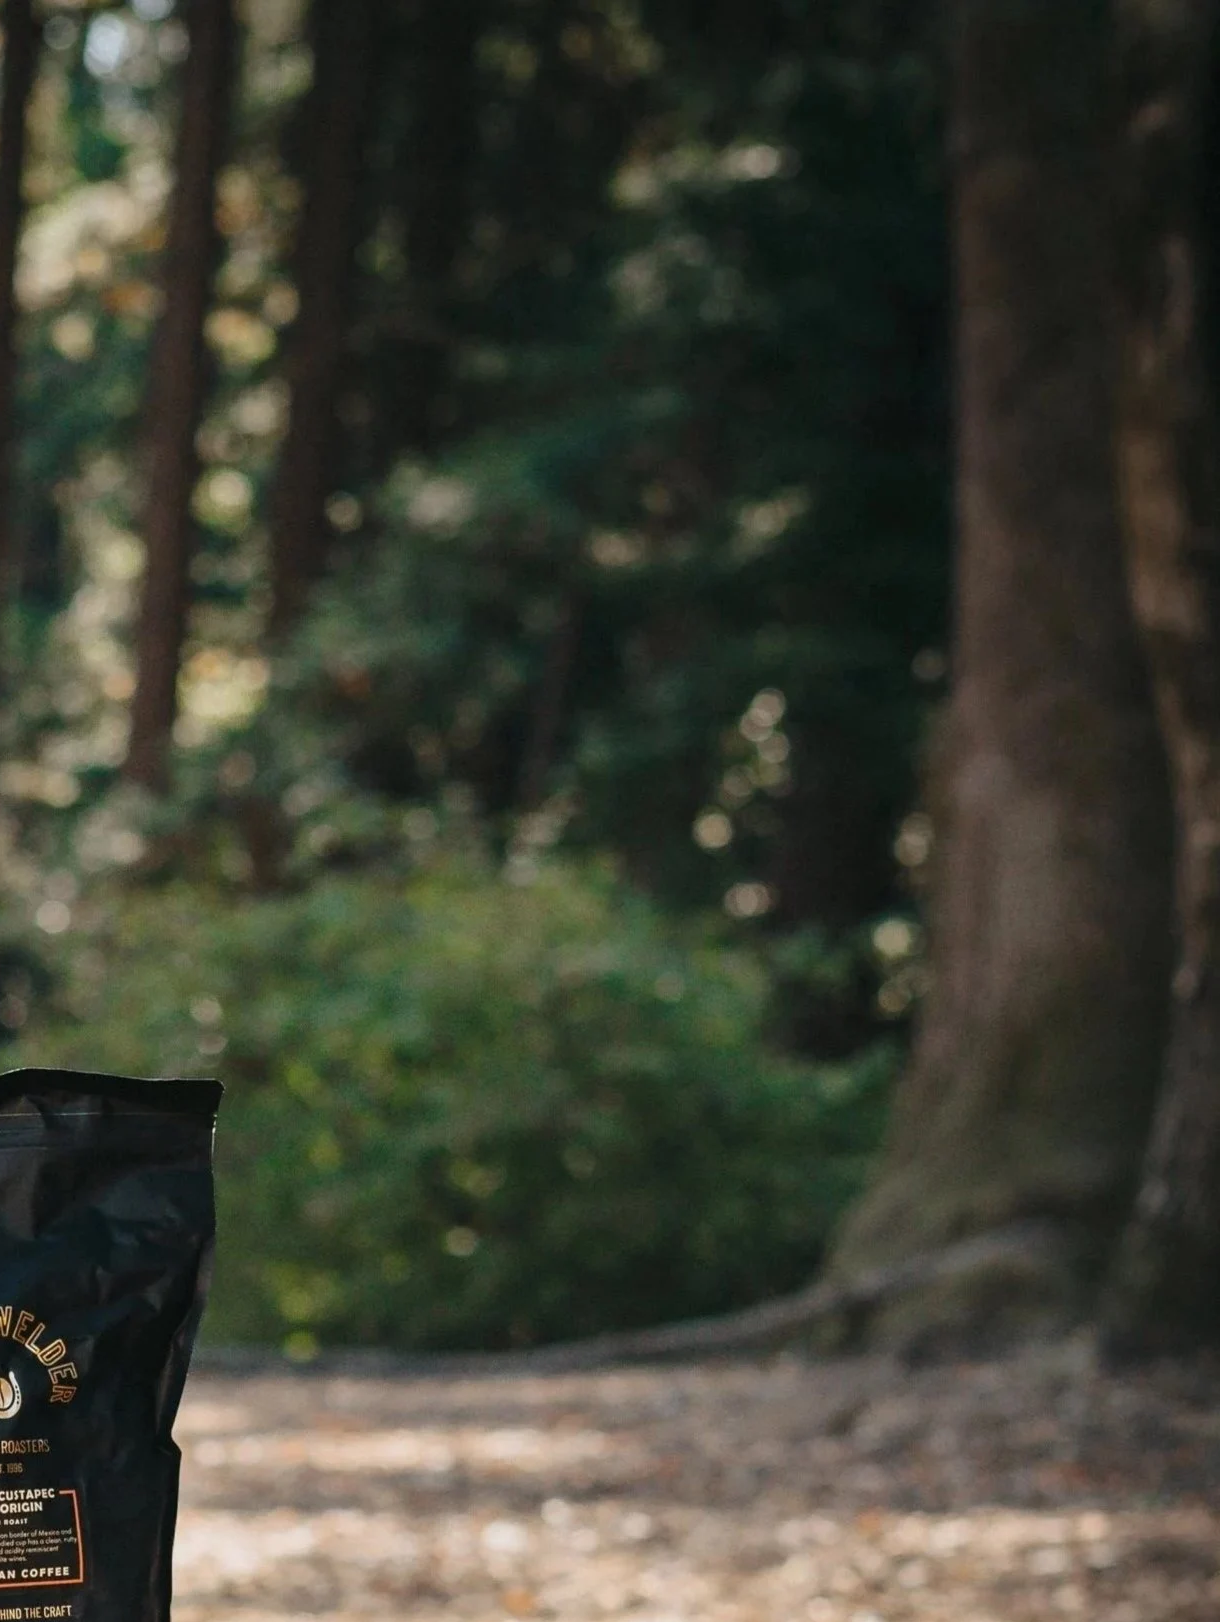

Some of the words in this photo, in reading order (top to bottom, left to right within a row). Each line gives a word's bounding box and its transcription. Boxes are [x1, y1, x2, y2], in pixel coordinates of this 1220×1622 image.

[1, 1439, 50, 1454] ROASTERS
[0, 1501, 43, 1514] ORIGIN
[3, 1518, 28, 1526] ROAST
[30, 1529, 37, 1537] of
[4, 1547, 25, 1555] acidity
[26, 1545, 59, 1553] reminiscent
[21, 1566, 70, 1578] COFFEE
[23, 1606, 41, 1619] THE
[43, 1605, 72, 1618] CRAFT
